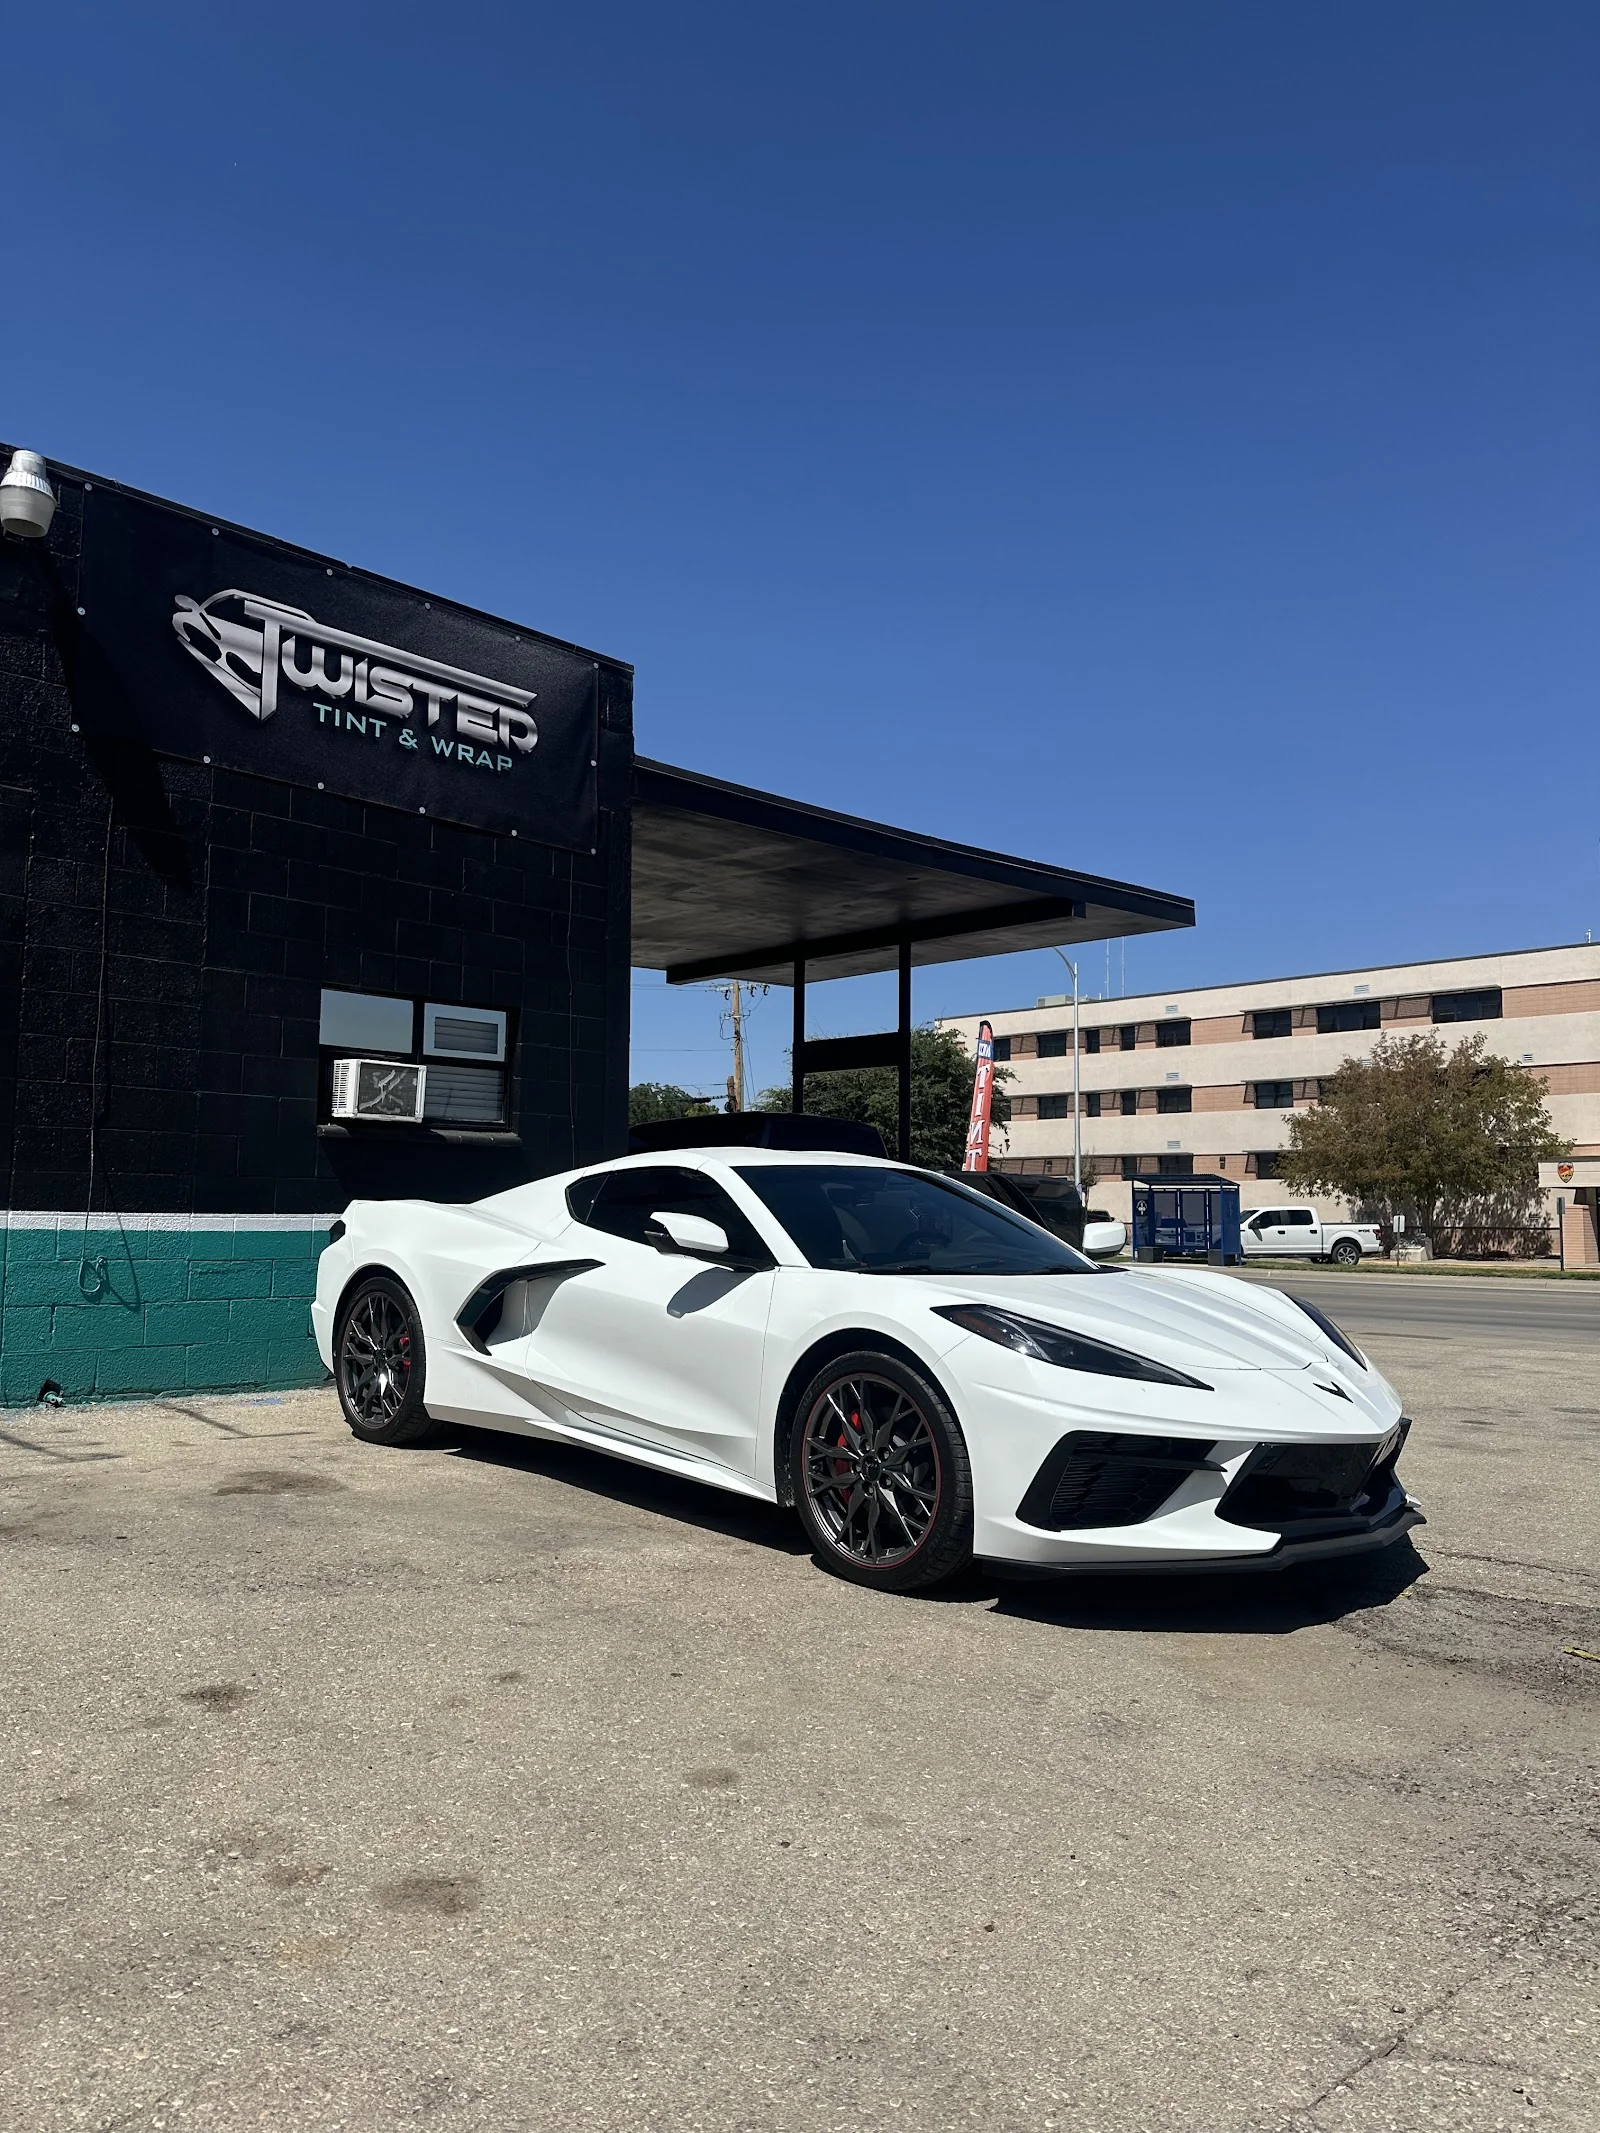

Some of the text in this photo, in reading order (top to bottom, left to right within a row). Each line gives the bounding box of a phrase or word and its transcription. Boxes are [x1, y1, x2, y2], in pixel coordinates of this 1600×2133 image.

[244, 599, 539, 754] TWISTED
[312, 702, 514, 772] TINT & WRAP
